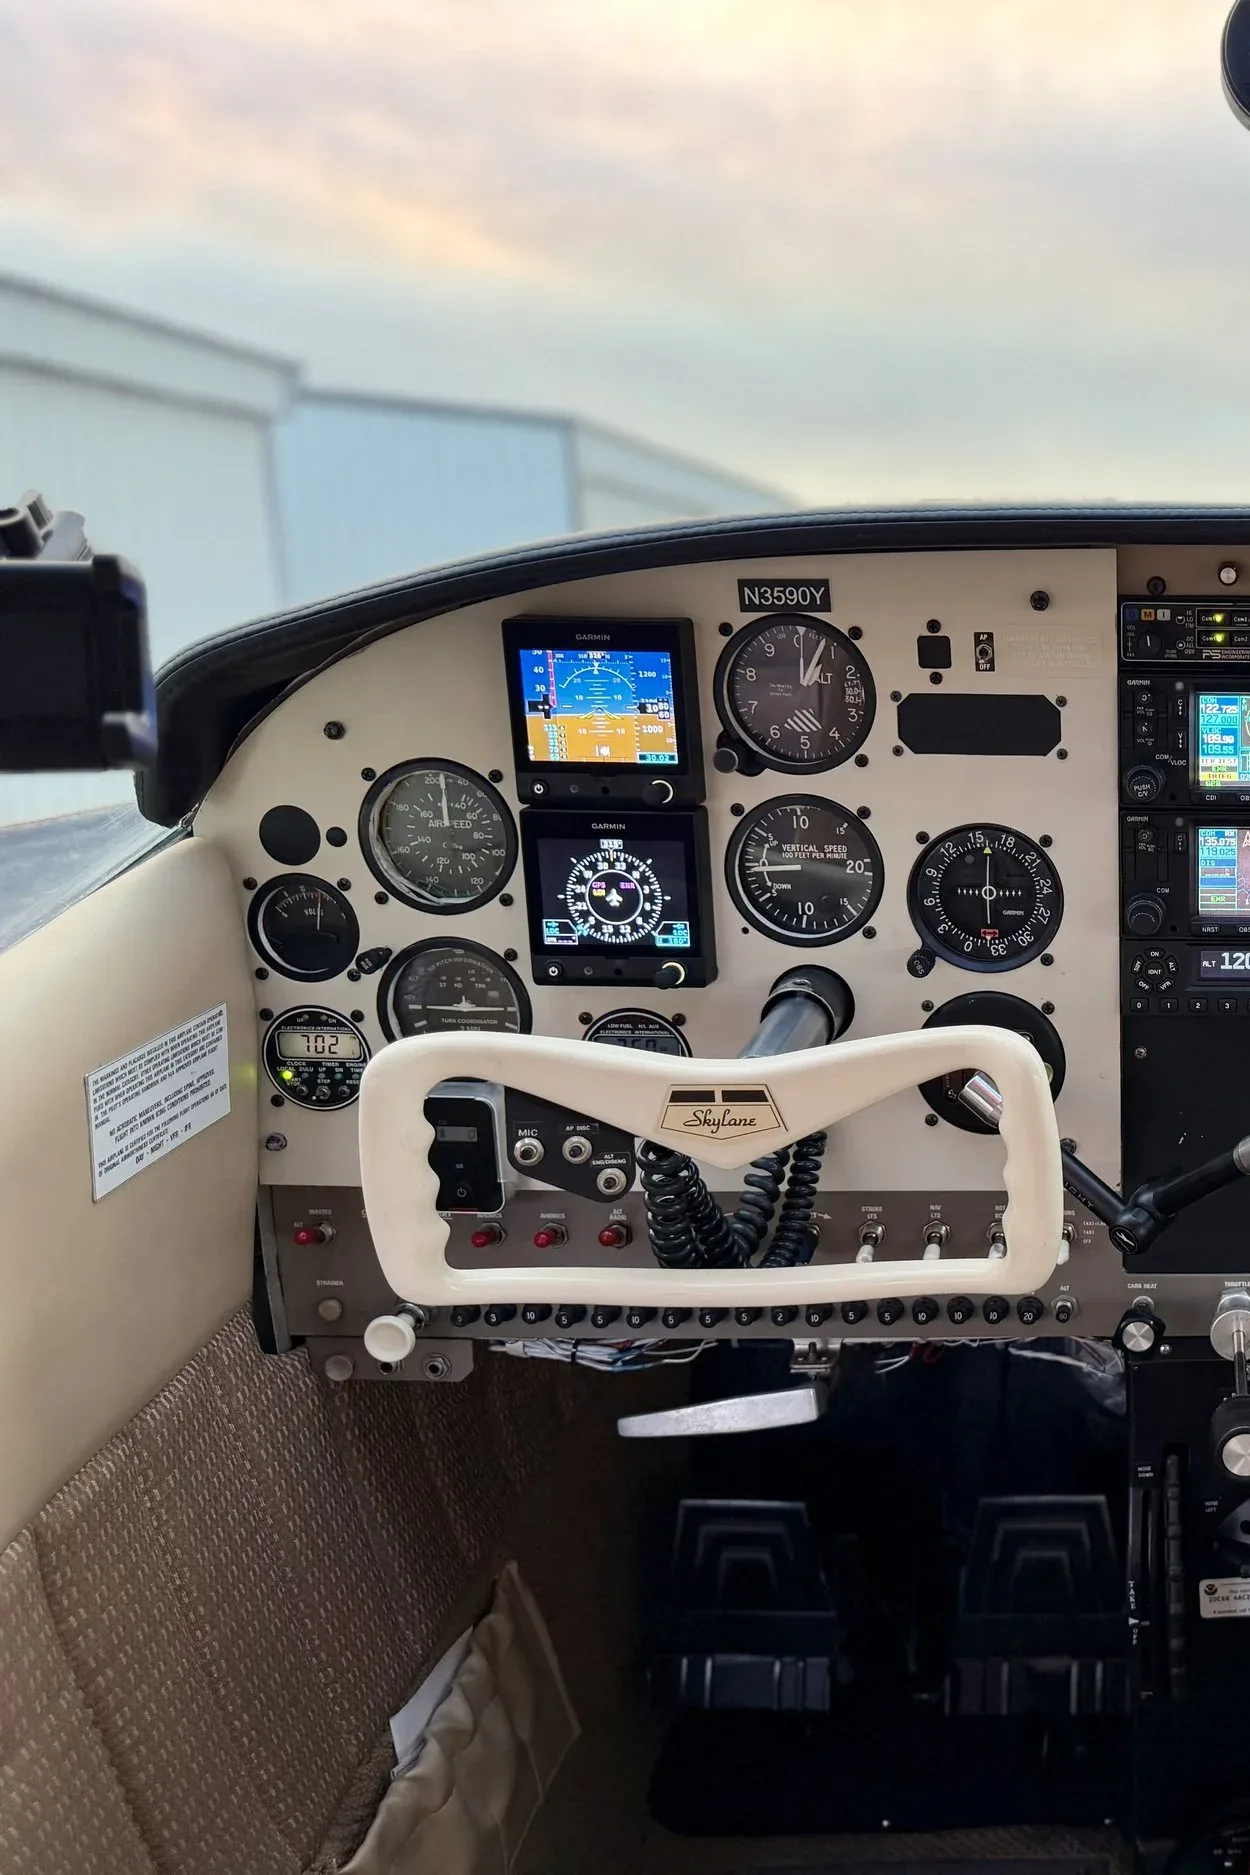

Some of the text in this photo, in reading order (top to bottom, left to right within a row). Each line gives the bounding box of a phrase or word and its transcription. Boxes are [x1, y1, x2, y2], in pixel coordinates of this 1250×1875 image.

[743, 587, 825, 605] N3590Y
[765, 644, 775, 657] 9
[746, 668, 756, 681] 8
[846, 666, 855, 679] 2
[748, 701, 758, 713] 7
[1201, 704, 1238, 713] 122.725
[848, 709, 857, 721] 3
[770, 725, 780, 738] 6
[829, 727, 840, 740] 4
[800, 736, 810, 749] 5
[793, 816, 808, 828] 10
[968, 831, 984, 843] 15
[1000, 834, 1015, 848] 18
[1200, 838, 1236, 846] 135.075
[782, 844, 817, 852] VERTICAL
[940, 842, 957, 856] 12
[1200, 847, 1236, 856] 119.025
[1025, 852, 1041, 867] 21
[846, 860, 864, 873] 20
[1040, 879, 1053, 894] 24
[798, 902, 814, 915] 10
[1037, 907, 1050, 925] 27
[1018, 932, 1034, 947] 30
[991, 944, 1007, 956] 33
[1203, 960, 1216, 968] ALT
[301, 1035, 338, 1054] 702
[683, 1109, 757, 1133] Skylane
[518, 1128, 538, 1137] MIC
[135, 1154, 144, 1164] DAY
[151, 1140, 164, 1154] NIGHT
[170, 1131, 179, 1141] VFR
[1224, 1280, 1250, 1288] THROTTLE
